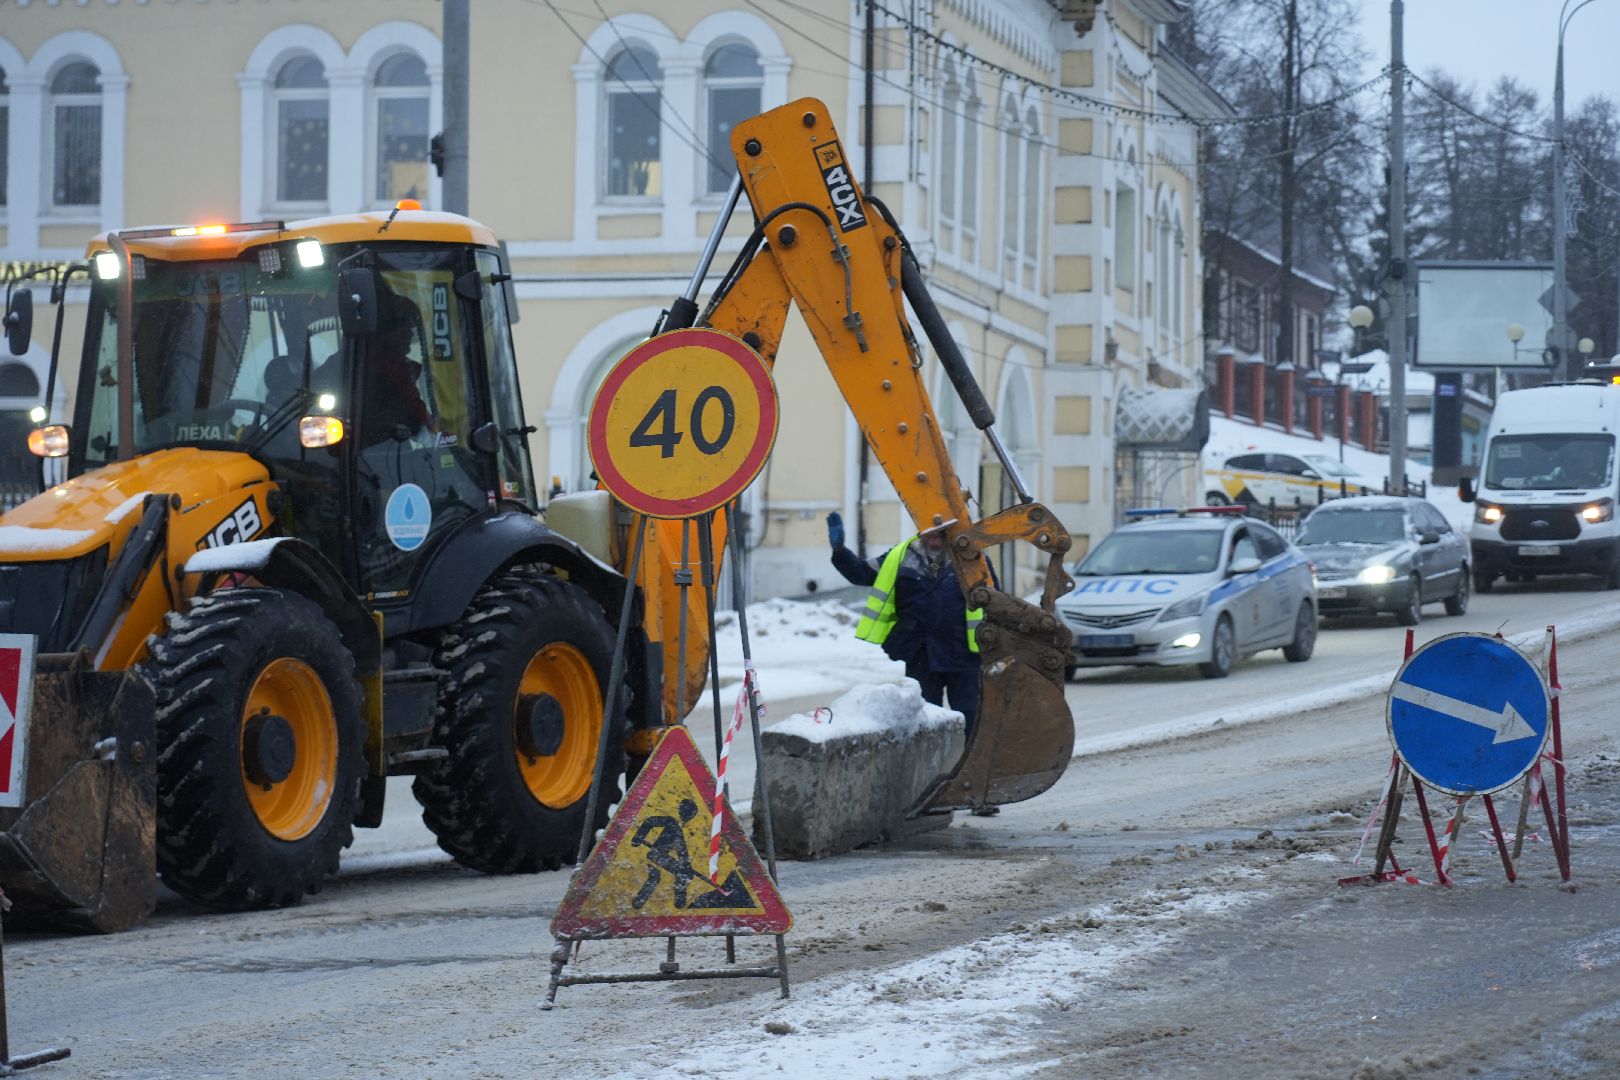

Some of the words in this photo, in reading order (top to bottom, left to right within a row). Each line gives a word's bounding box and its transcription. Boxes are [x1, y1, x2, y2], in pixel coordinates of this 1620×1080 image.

[826, 166, 864, 225] 4CX
[433, 286, 453, 358] JCB
[176, 422, 222, 441] ЛЁХА
[629, 385, 736, 459] 40
[1072, 579, 1180, 597] ДПС
